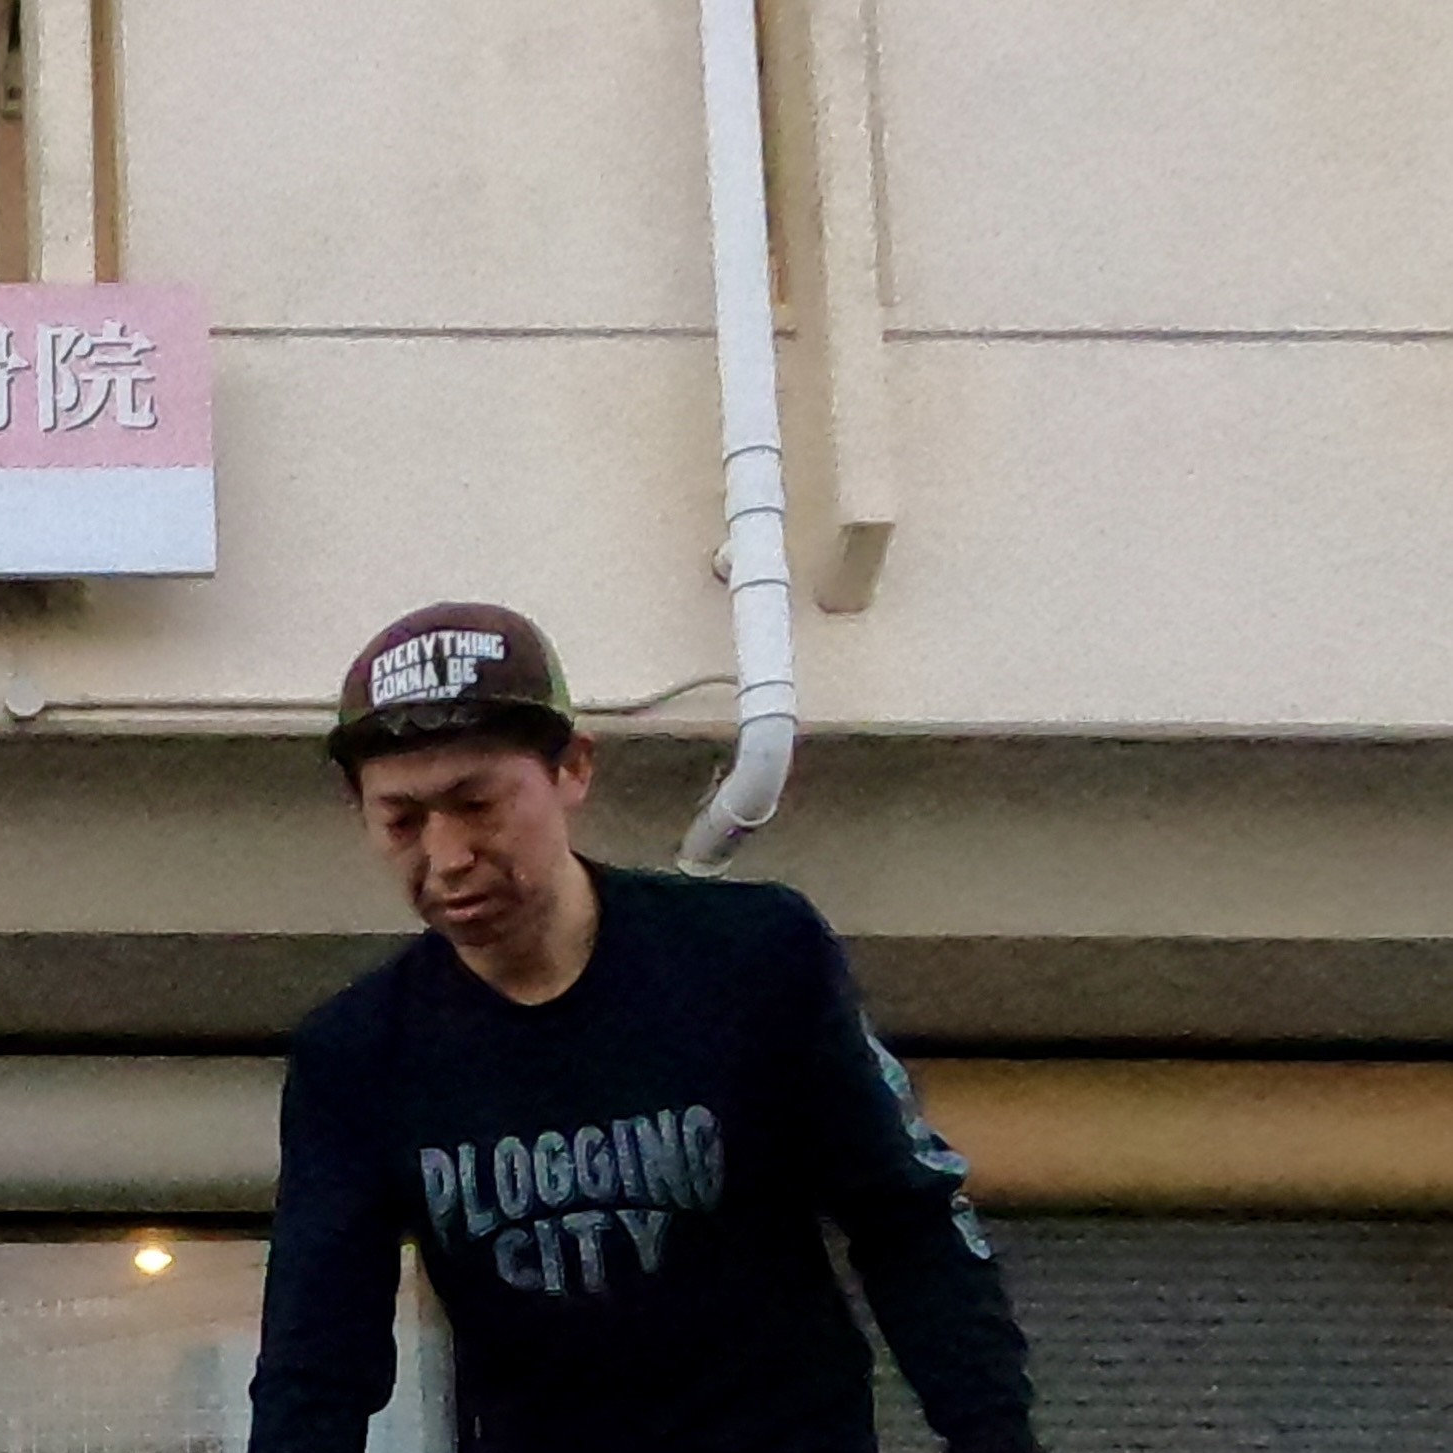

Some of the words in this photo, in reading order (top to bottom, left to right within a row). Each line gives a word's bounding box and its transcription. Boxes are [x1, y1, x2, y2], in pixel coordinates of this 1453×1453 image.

[372, 630, 505, 680] EVERYTHING
[372, 660, 439, 708] GONNA
[448, 657, 478, 685] BE
[419, 1104, 726, 1244] PLOGGING
[493, 1209, 670, 1296] CITY
